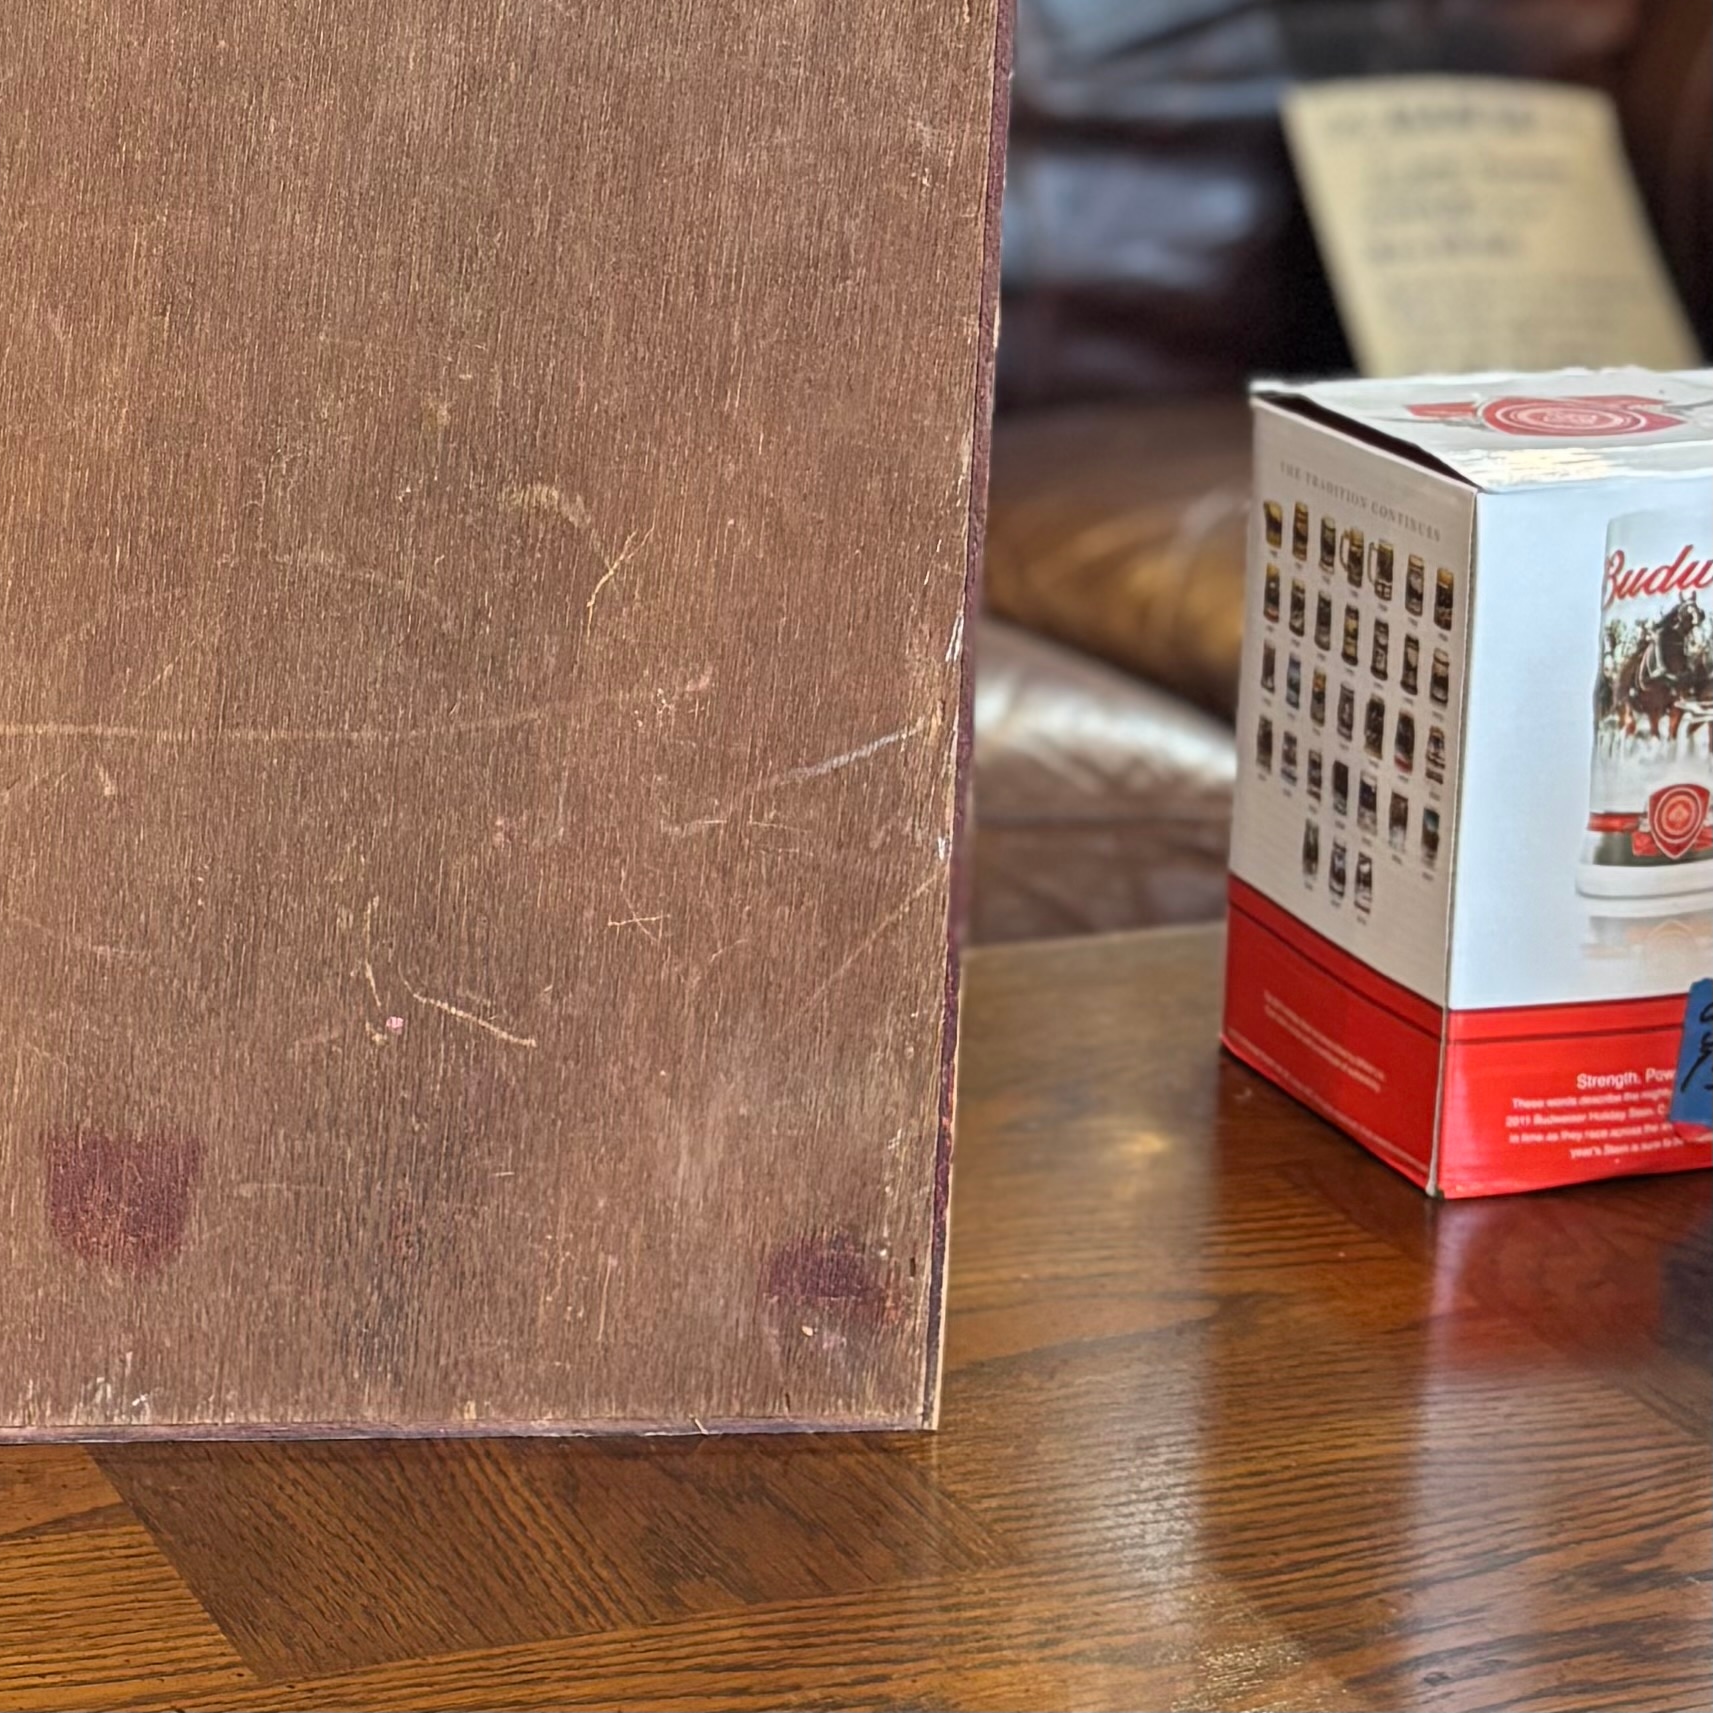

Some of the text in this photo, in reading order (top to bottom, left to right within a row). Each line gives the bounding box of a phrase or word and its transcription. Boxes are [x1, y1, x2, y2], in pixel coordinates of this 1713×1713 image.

[1306, 472, 1368, 509] TRADITION
[1371, 501, 1441, 543] CONTINUES
[1576, 1070, 1641, 1090] Strength.
[1533, 1113, 1586, 1126] Budweiser
